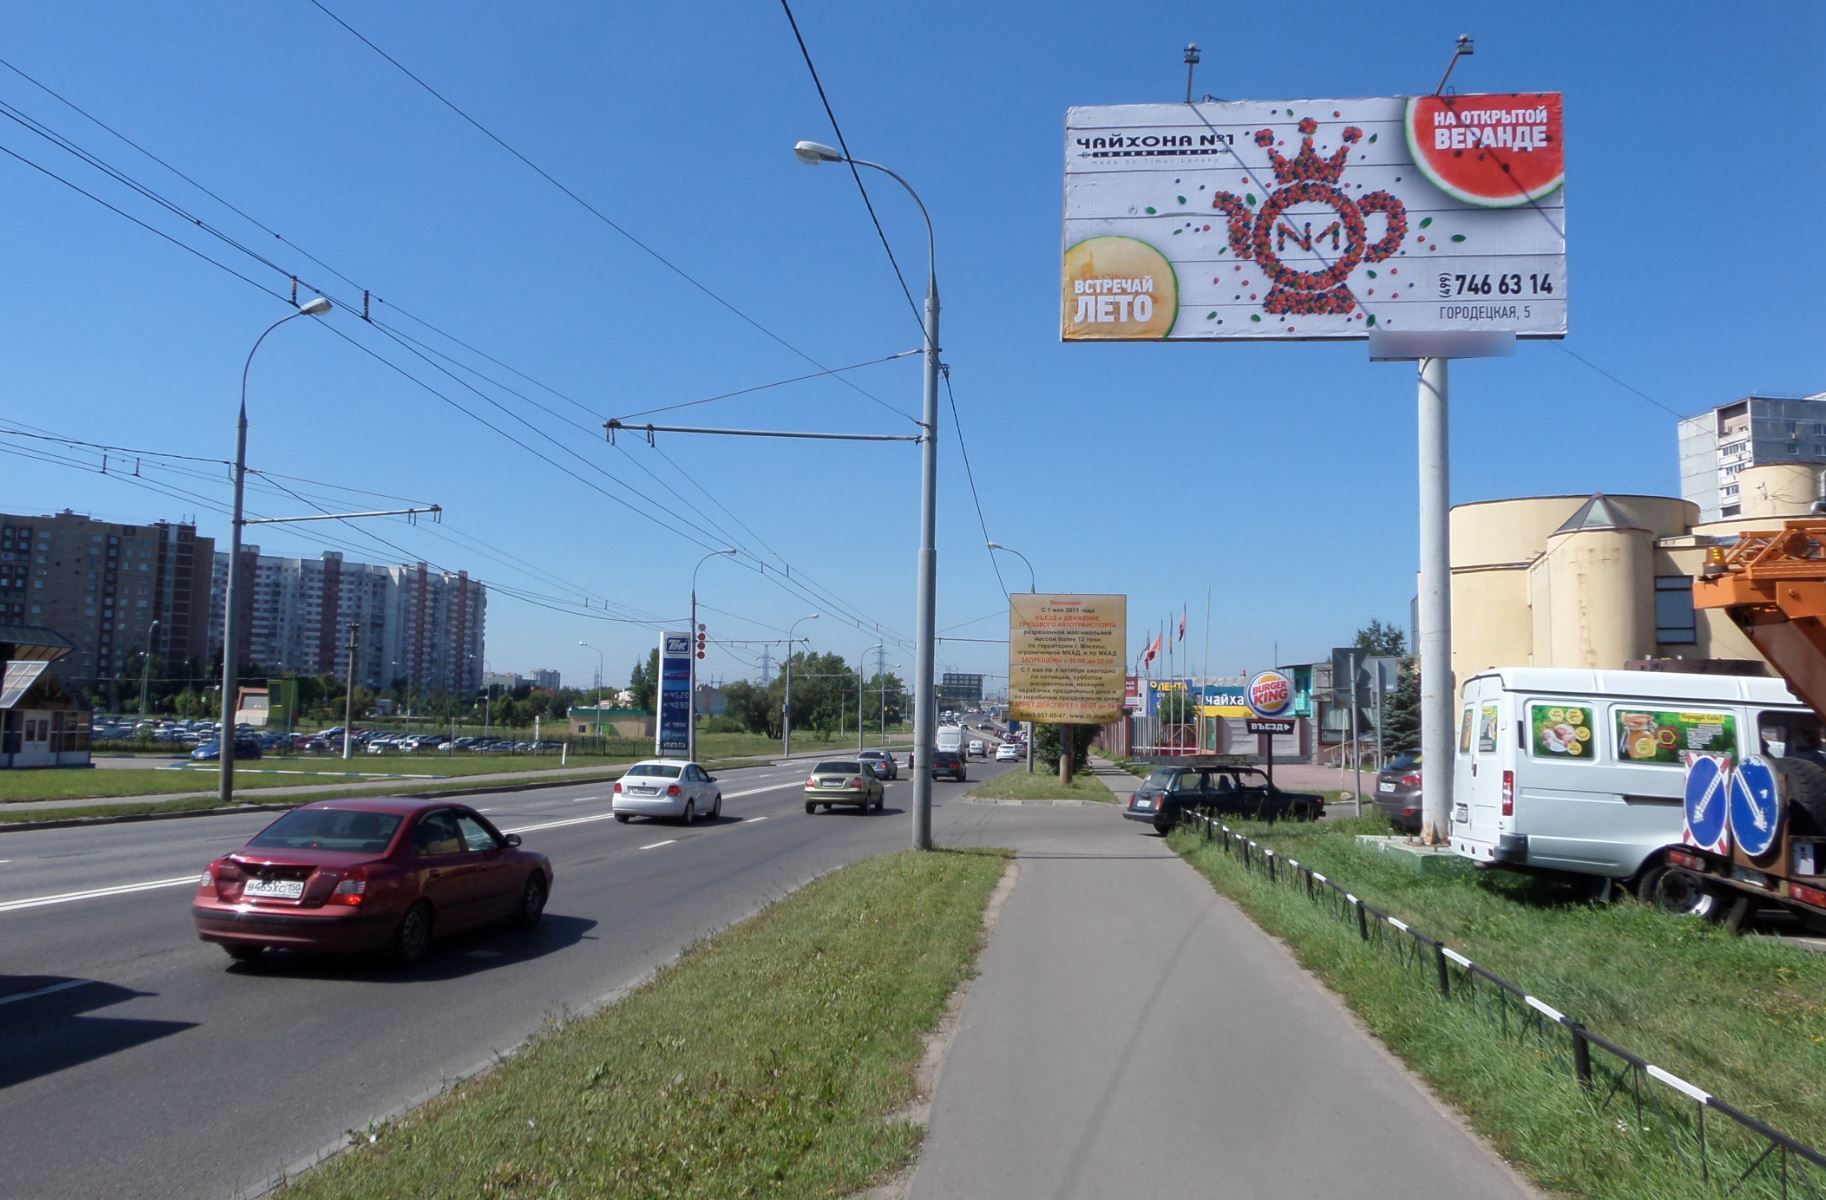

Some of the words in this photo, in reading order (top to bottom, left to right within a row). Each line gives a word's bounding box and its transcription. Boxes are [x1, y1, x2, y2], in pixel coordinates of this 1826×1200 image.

[1433, 111, 1457, 126] НА
[1460, 105, 1548, 125] ОТКРЫТОЙ
[1076, 133, 1193, 149] ЧАЙХОНА
[1199, 134, 1235, 147] №1
[1434, 125, 1548, 152] ВЕРАНДЕ
[1074, 275, 1154, 294] ВСТРЕЧАЙ
[1454, 273, 1493, 296] 746
[1498, 273, 1522, 295] 63
[1529, 273, 1554, 295] 14
[1073, 294, 1153, 323] ЛЕТО
[1439, 305, 1520, 321] ГОРОДЕЦКАЯ,
[1524, 305, 1531, 319] 5
[1252, 681, 1288, 695] BURGER
[1253, 688, 1288, 705] KING
[1250, 722, 1284, 731] ВЪЕЗД
